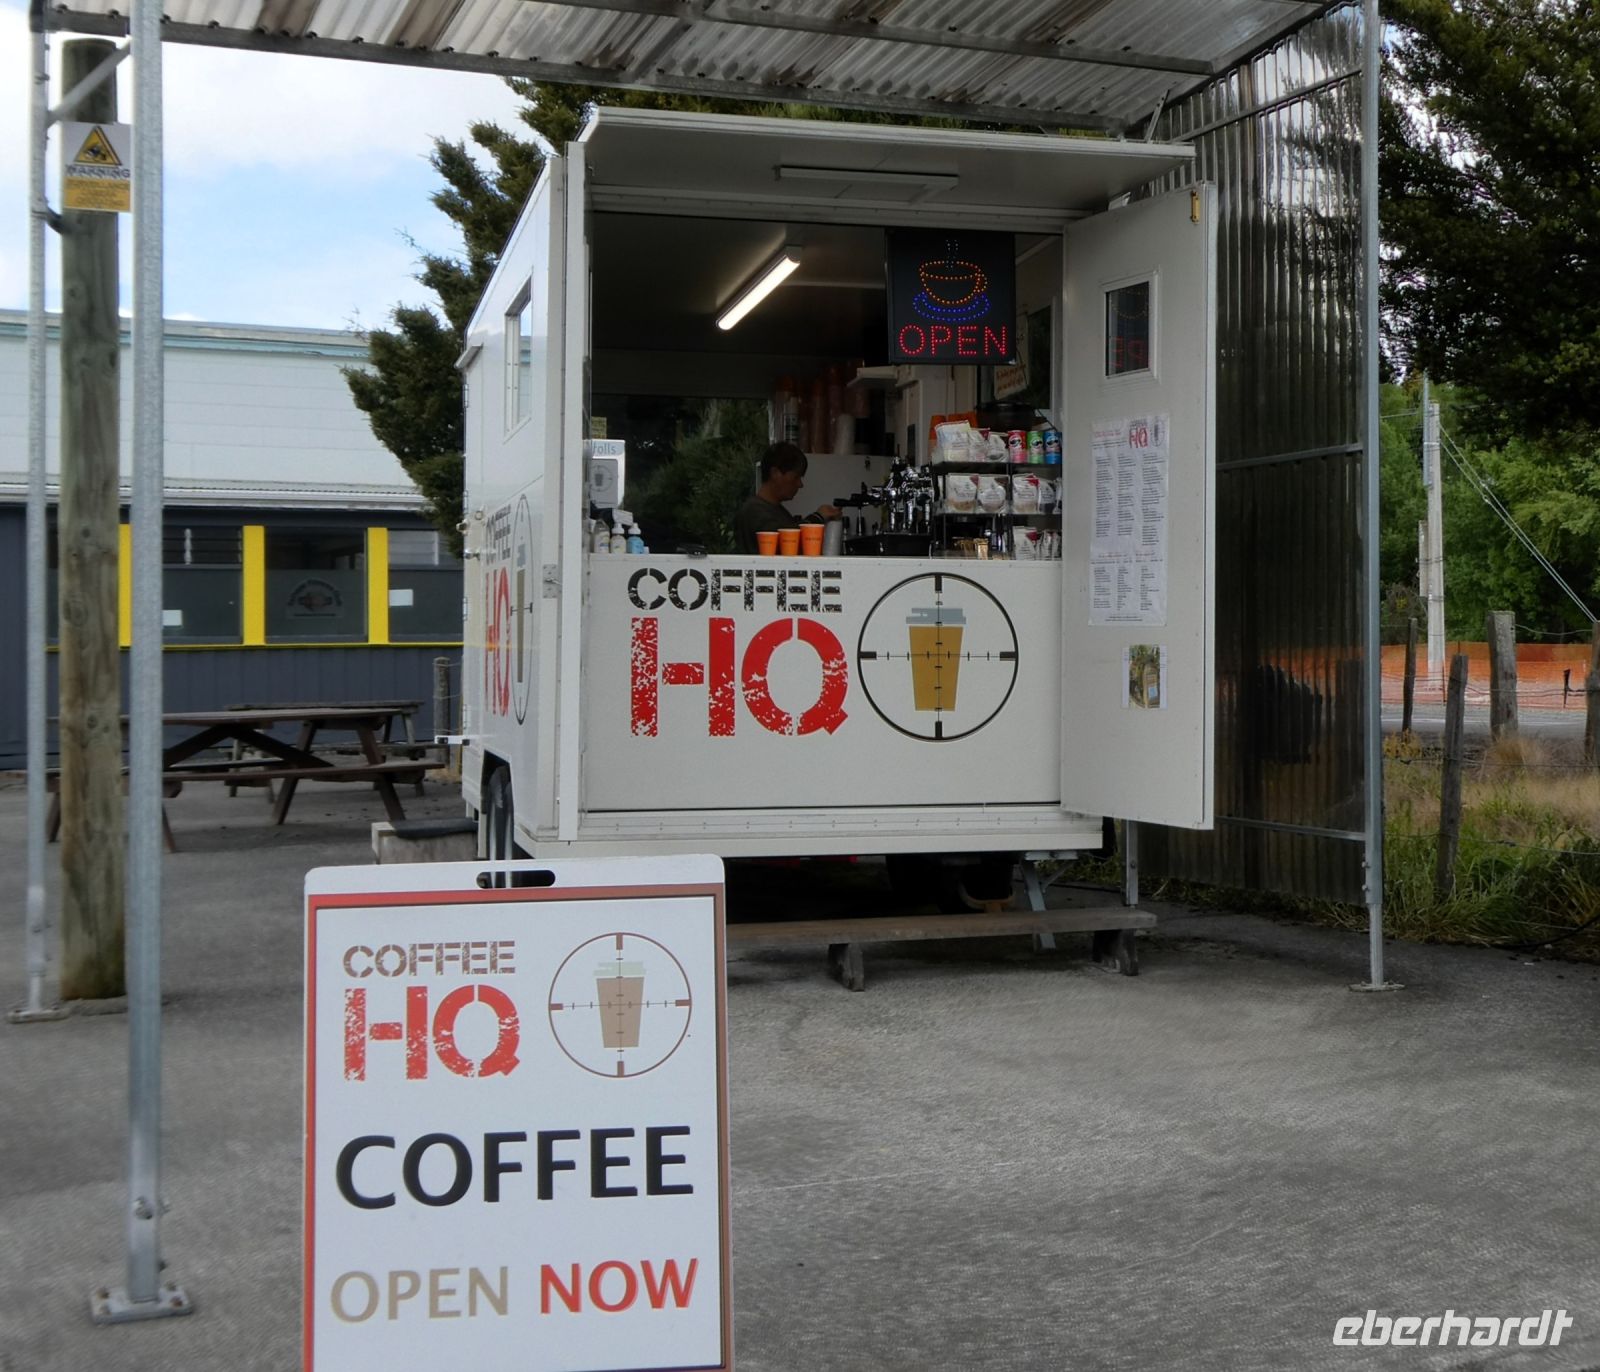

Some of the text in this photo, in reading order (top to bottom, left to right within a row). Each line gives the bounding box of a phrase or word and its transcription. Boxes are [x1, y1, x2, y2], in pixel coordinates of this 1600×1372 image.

[66, 165, 131, 178] WARNING
[899, 324, 1007, 355] OPEN
[628, 568, 842, 612] COFFEE
[631, 617, 848, 737] HQ
[343, 940, 516, 978] COFFEE
[344, 984, 520, 1081] HQ
[335, 1126, 694, 1209] COFFEE
[330, 1258, 698, 1323] OPEN NOW
